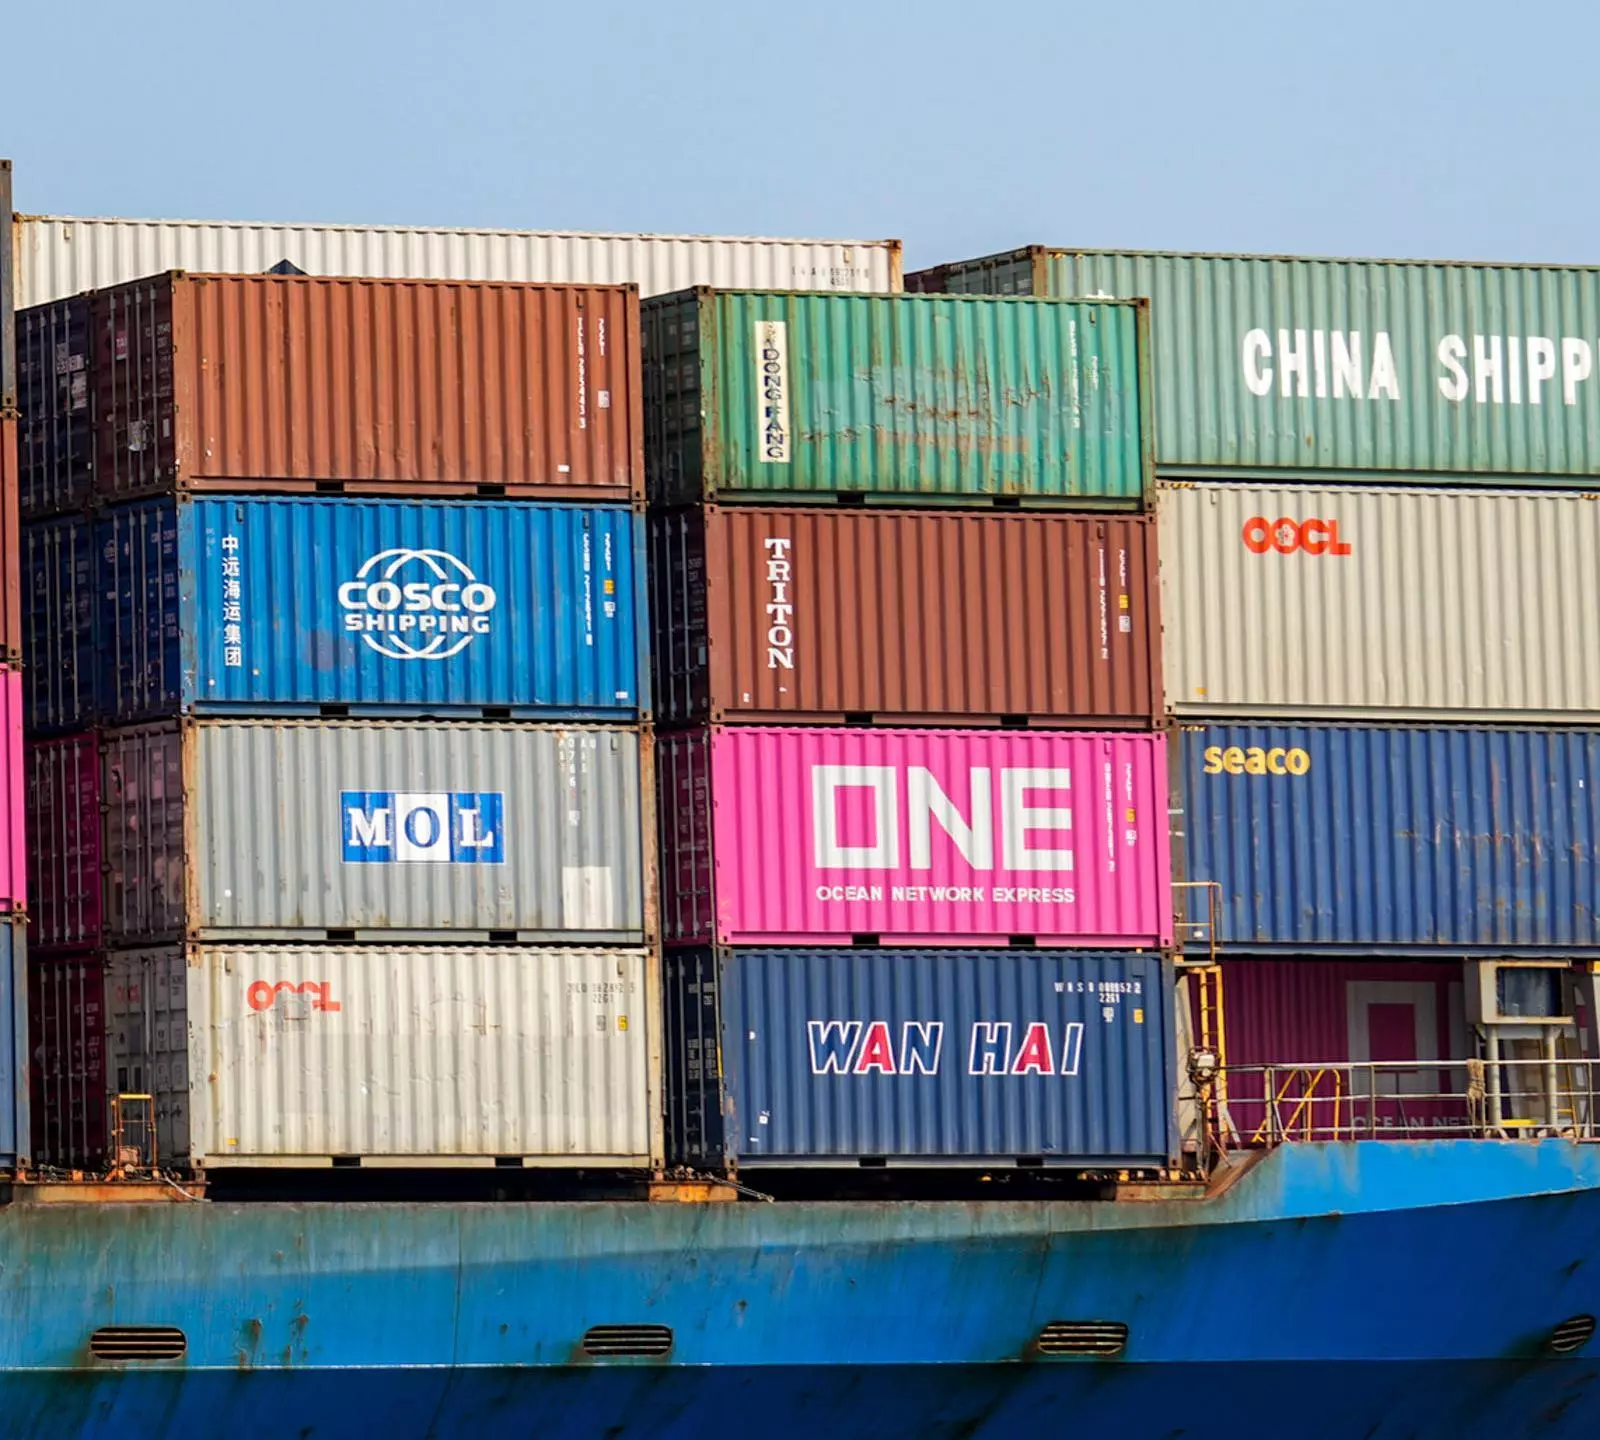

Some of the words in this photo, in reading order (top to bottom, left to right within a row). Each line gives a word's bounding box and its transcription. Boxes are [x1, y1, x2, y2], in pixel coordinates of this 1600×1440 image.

[763, 348, 782, 401] DONG
[1243, 328, 1400, 400] CHINA
[1437, 334, 1600, 405] SHIPP
[1242, 516, 1351, 556] OOCL
[220, 533, 242, 667] 中远海运集团
[338, 581, 497, 613] COSCO
[765, 538, 794, 669] TRITON
[344, 613, 490, 634] SHIPPING
[1203, 746, 1311, 776] seaco
[347, 806, 494, 849] MOL
[811, 764, 1074, 871] ONE
[816, 886, 883, 902] OCEAN
[891, 887, 985, 903] NETWORK
[992, 888, 1075, 904] EXPRESS
[808, 1021, 944, 1074] WAN
[969, 1022, 1085, 1075] HAI
